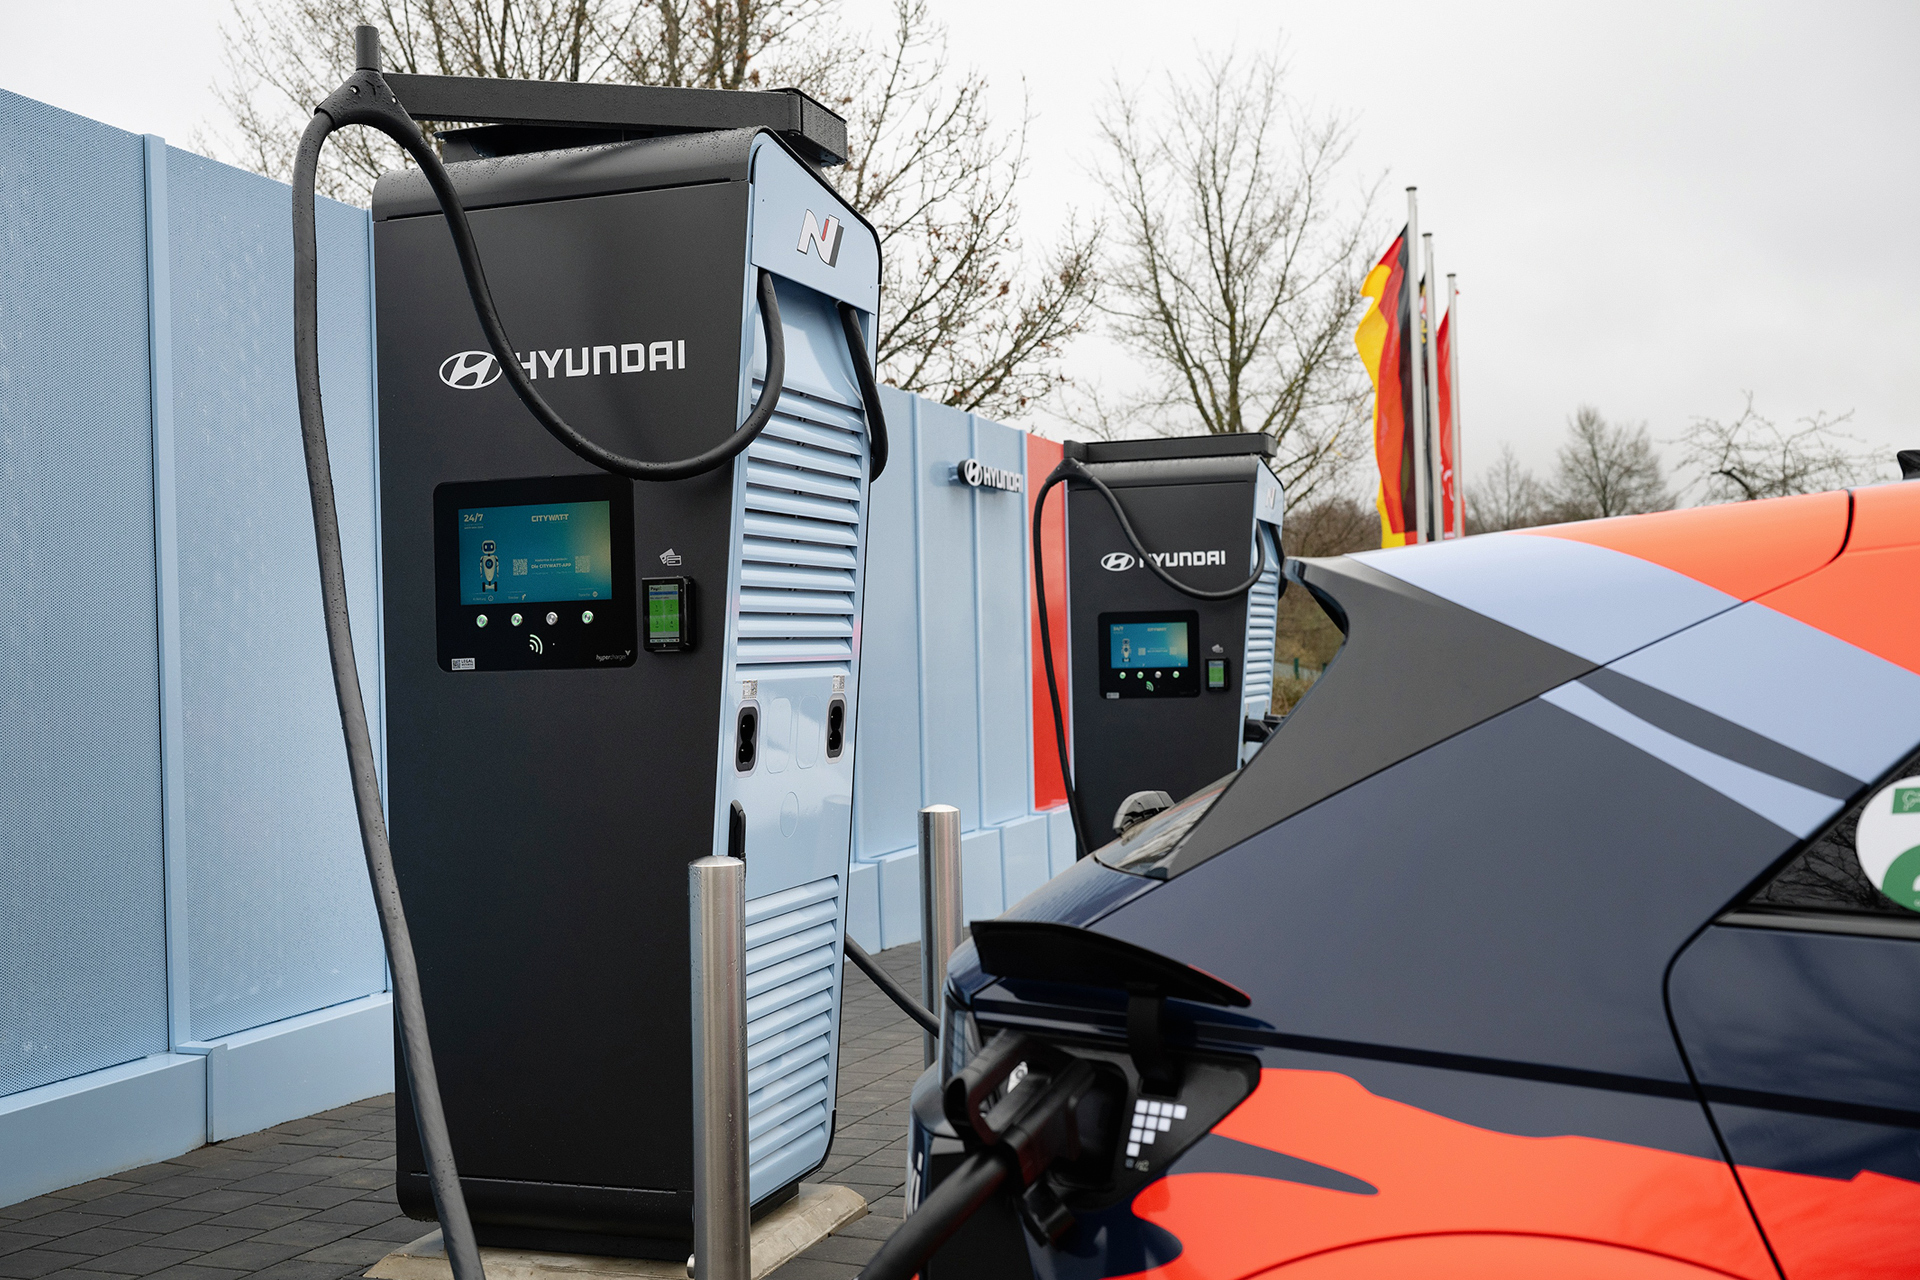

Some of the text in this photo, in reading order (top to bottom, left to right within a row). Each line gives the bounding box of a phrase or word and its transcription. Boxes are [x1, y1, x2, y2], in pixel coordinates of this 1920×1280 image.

[983, 466, 1024, 493] HYUNDAI
[463, 512, 484, 523] 24/7
[531, 513, 569, 523] CITYWATT
